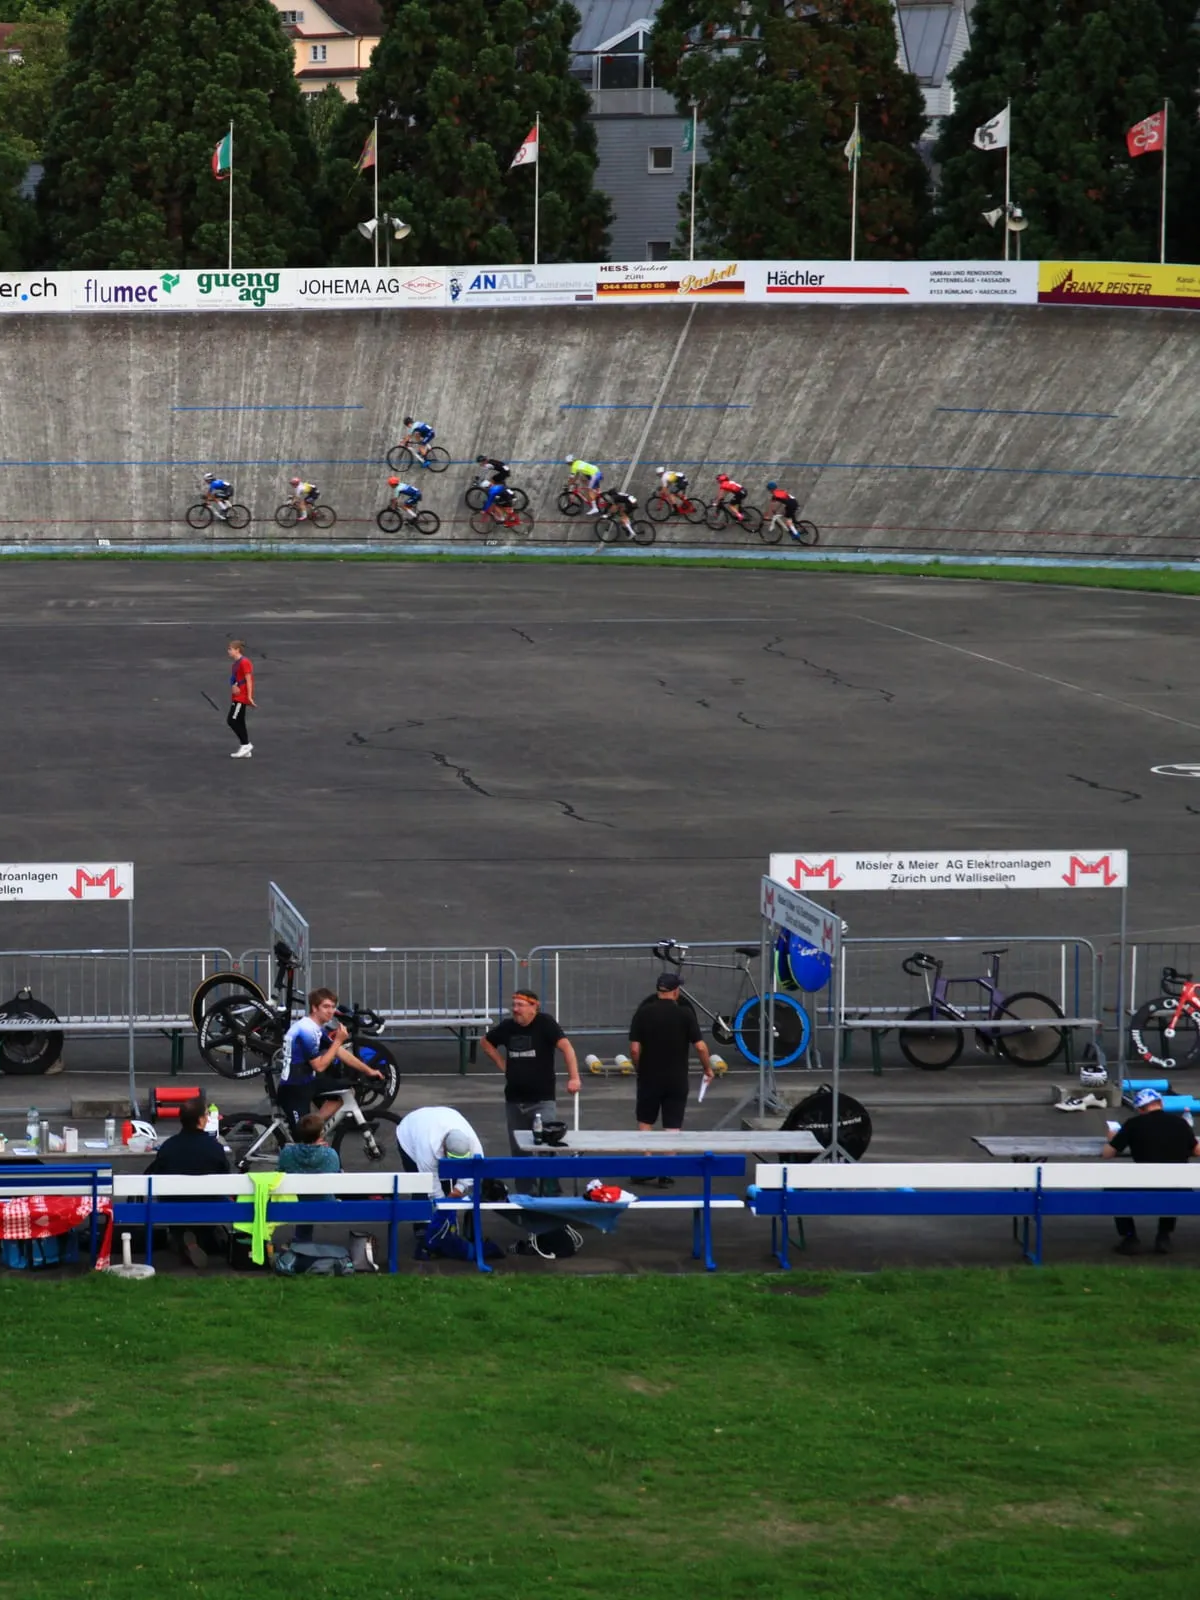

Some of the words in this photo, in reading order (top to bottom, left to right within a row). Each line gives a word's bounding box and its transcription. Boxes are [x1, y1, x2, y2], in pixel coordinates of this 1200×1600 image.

[197, 272, 281, 294] gueng
[299, 279, 371, 294] JOHEMA
[376, 278, 400, 294] AG
[469, 274, 536, 290] ANALP
[767, 271, 825, 286] Hächler
[84, 279, 158, 303] flumec
[1063, 280, 1102, 294] FRANZ
[1106, 281, 1152, 296] PFISTER
[238, 287, 268, 307] ag
[856, 859, 893, 871] Mösler
[897, 859, 905, 870] &
[908, 859, 939, 870] Meier
[946, 859, 963, 869] AG
[967, 857, 1052, 870] Elektroanlagen
[891, 872, 927, 883] Zürich
[931, 872, 952, 883] und
[954, 871, 1016, 883] Wallisellen
